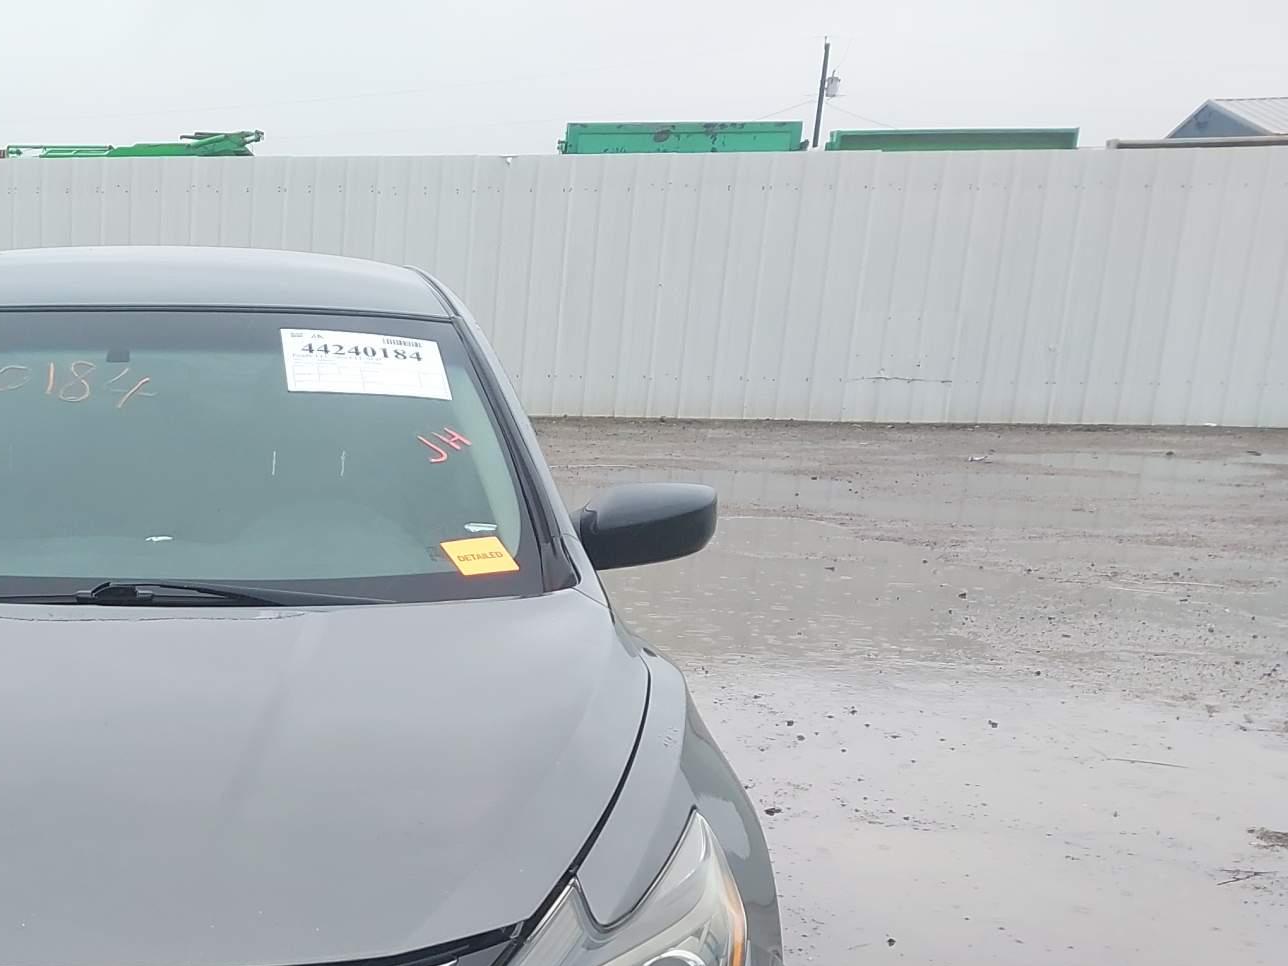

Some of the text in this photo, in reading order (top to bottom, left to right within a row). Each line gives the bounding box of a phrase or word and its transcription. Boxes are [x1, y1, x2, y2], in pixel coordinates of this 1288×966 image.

[300, 342, 424, 362] 44240184
[417, 427, 473, 464] JH
[456, 550, 505, 563] DETAILED
